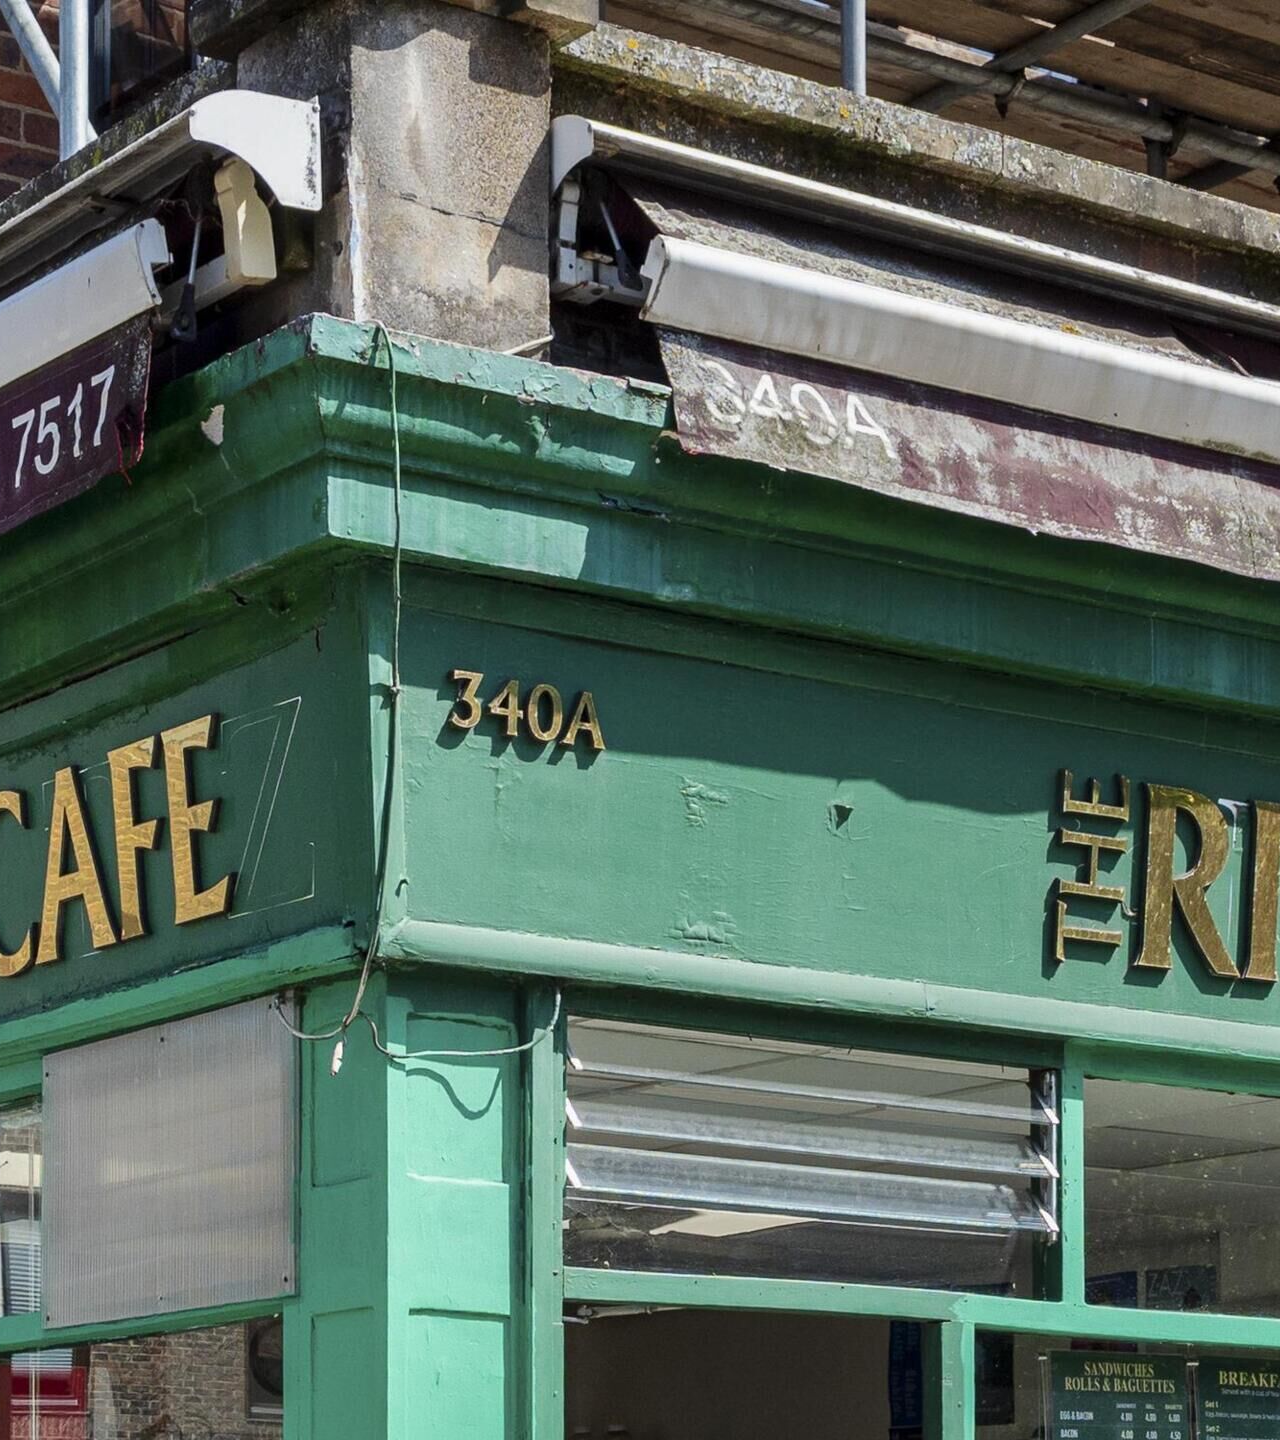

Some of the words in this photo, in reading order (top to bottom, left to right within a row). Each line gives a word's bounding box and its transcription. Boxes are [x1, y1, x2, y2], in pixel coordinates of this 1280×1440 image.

[13, 366, 115, 489] 7517
[451, 668, 605, 752] 340A
[1055, 768, 1131, 964] THE
[1065, 1377, 1100, 1391] ROLLS
[1102, 1378, 1111, 1391] &
[1114, 1379, 1175, 1394] BAGUETTES
[1084, 1362, 1154, 1377] SANDWICHES
